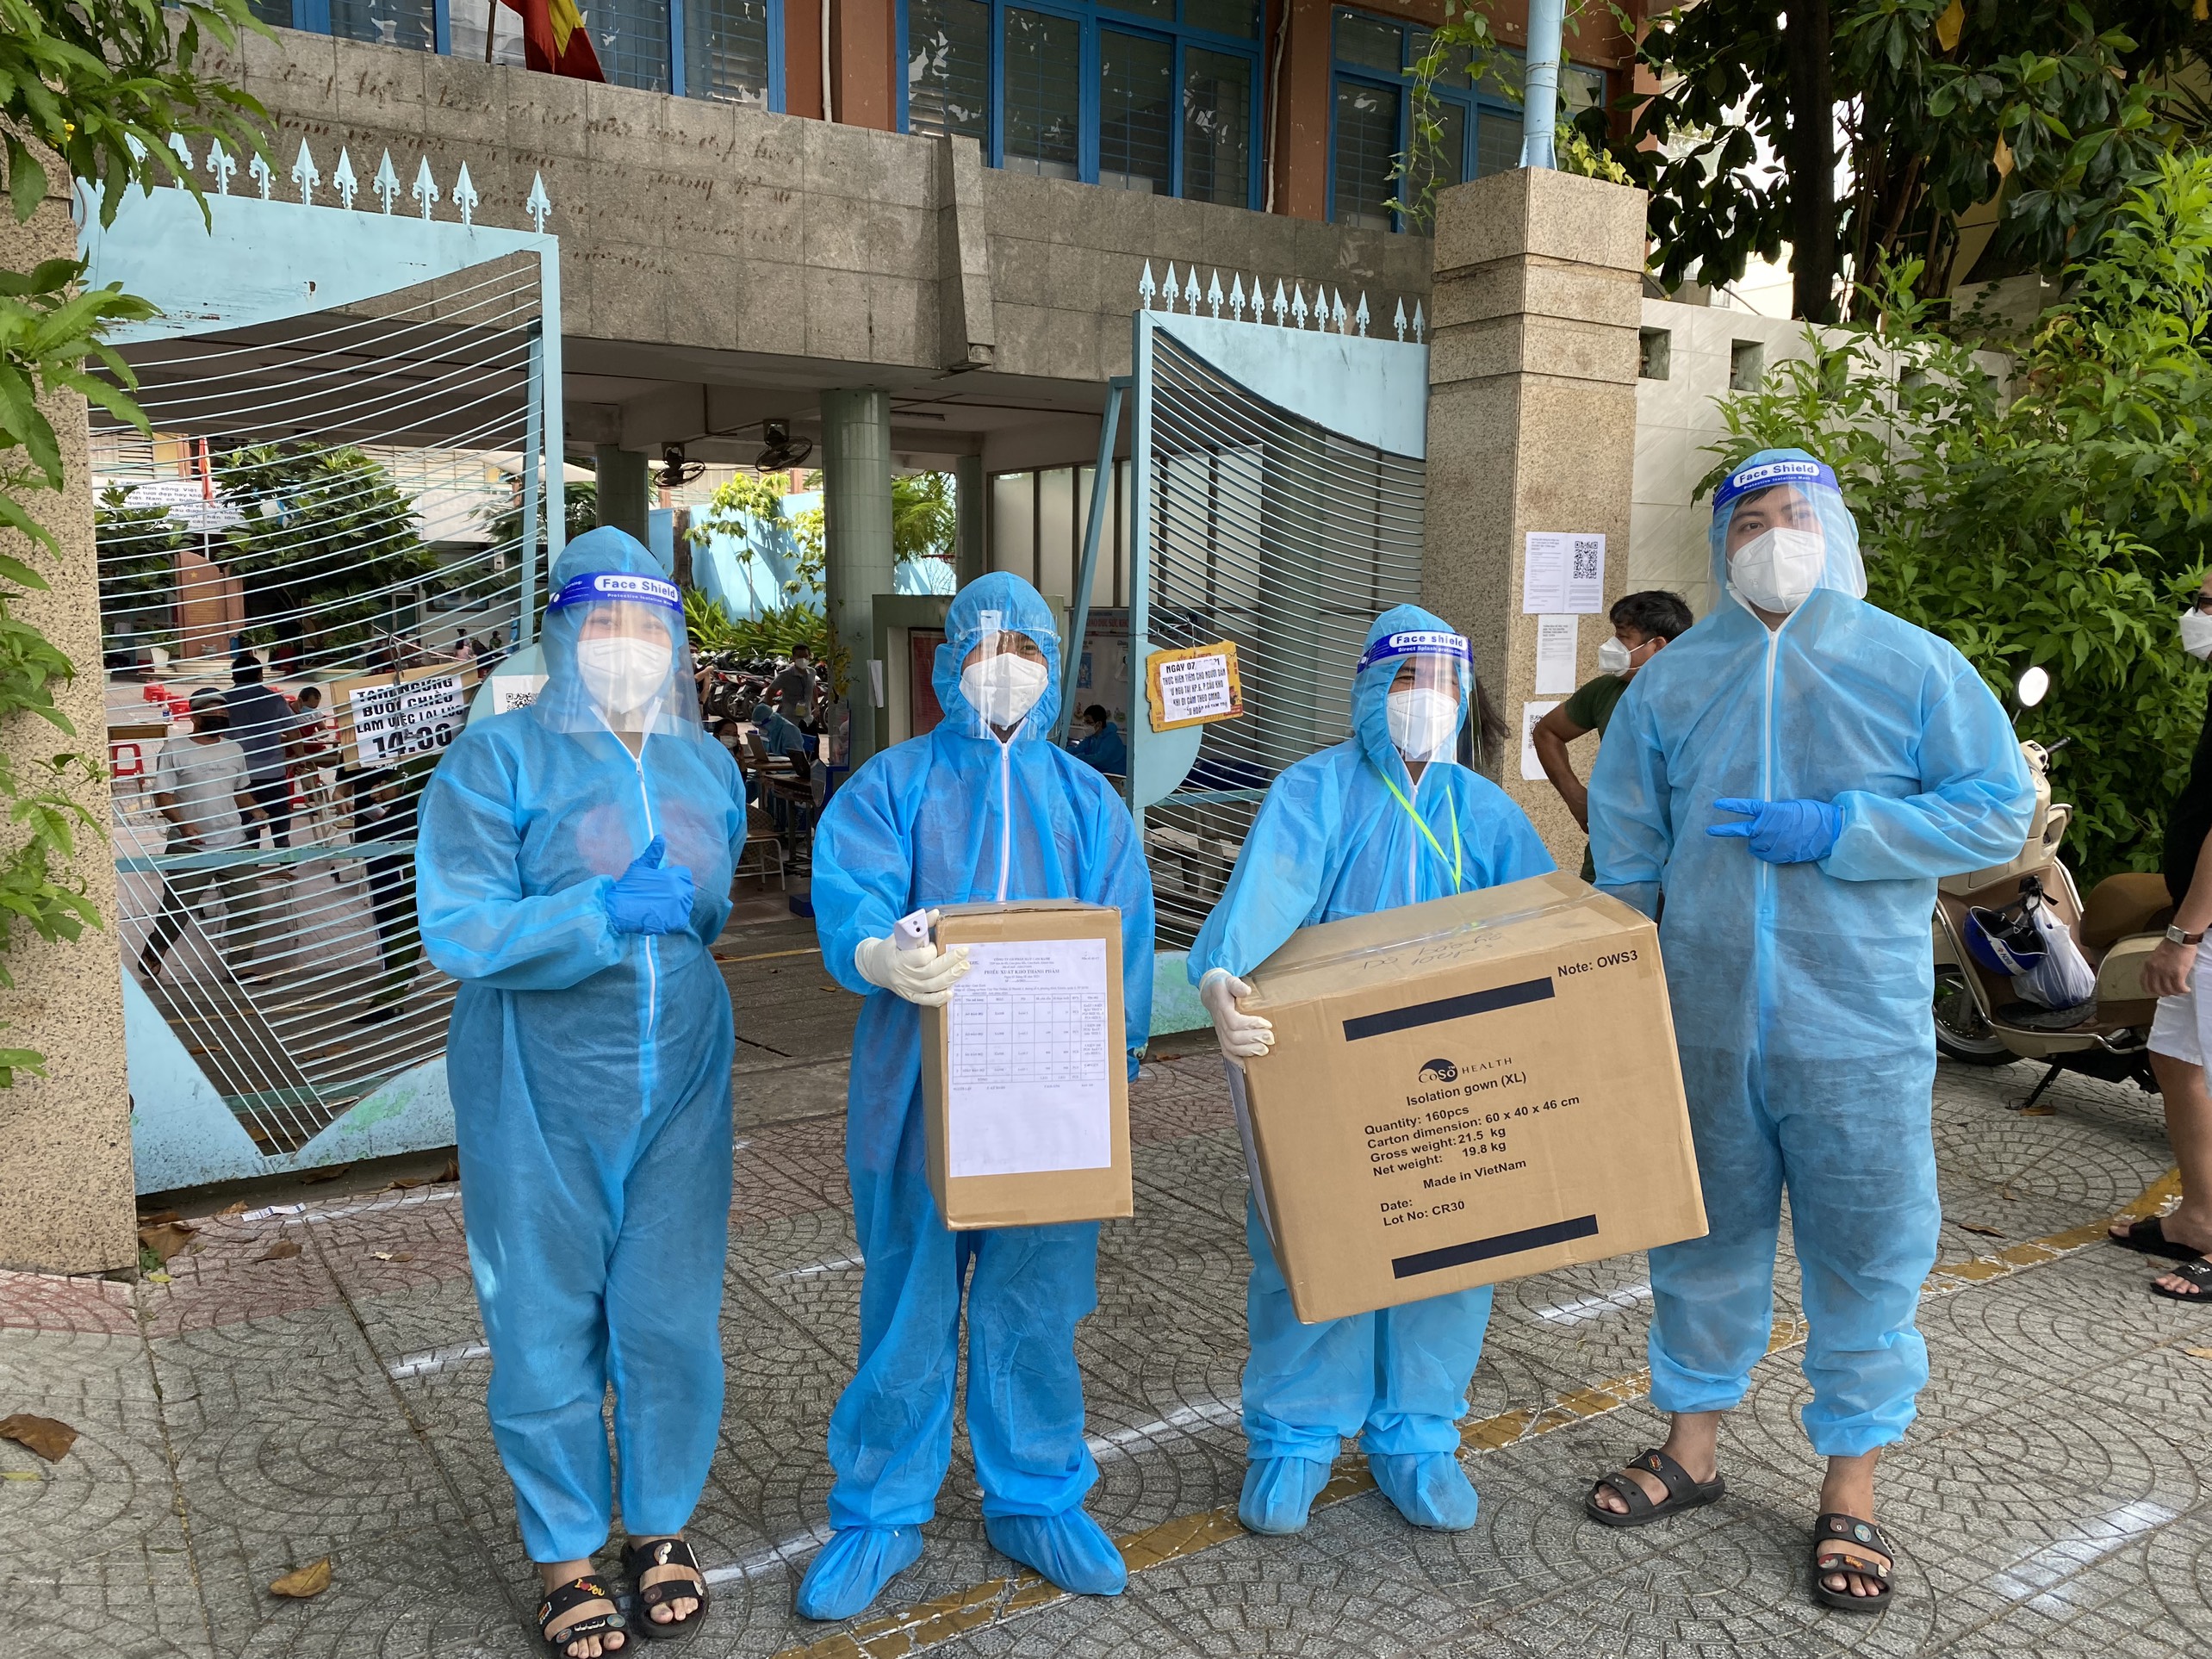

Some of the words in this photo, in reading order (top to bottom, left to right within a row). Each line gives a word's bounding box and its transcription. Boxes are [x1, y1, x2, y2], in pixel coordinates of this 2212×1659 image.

[1740, 469, 1768, 483] Face
[1774, 464, 1814, 474] Shield
[603, 578, 637, 589] Face
[642, 581, 675, 599] Shield
[1396, 635, 1426, 644] Face
[1432, 635, 1463, 647] shield
[1557, 962, 1593, 977] Note:
[1597, 950, 1637, 968] OWS3
[1462, 1057, 1513, 1074] HEALTH
[1407, 1088, 1460, 1106] Isolation
[1464, 1080, 1498, 1096] gown
[1501, 1071, 1526, 1088] (XL)
[1364, 1117, 1422, 1134] Quantity:
[1426, 1107, 1469, 1122] 160pcs
[1368, 1134, 1409, 1148] Carton
[1413, 1118, 1482, 1139] dimension:
[1485, 1112, 1500, 1123] 60
[1514, 1106, 1528, 1116] 40
[1543, 1100, 1557, 1110] 46
[1561, 1097, 1580, 1107] cm
[1370, 1149, 1407, 1162] Gross
[1411, 1137, 1457, 1152] weight:
[1458, 1130, 1483, 1144] 21.5
[1490, 1128, 1506, 1138] kg
[1373, 1165, 1395, 1176] Net
[1397, 1155, 1443, 1169] weight:
[1462, 1144, 1488, 1157] 19.8
[1491, 1142, 1507, 1152] kg
[1423, 1176, 1457, 1189] Made
[1460, 1171, 1471, 1181] in
[1474, 1160, 1526, 1177] VietNam
[1380, 1199, 1413, 1212] Date:
[1383, 1215, 1404, 1227] Lot
[1407, 1209, 1429, 1221] No:
[1432, 1201, 1464, 1215] CR30
